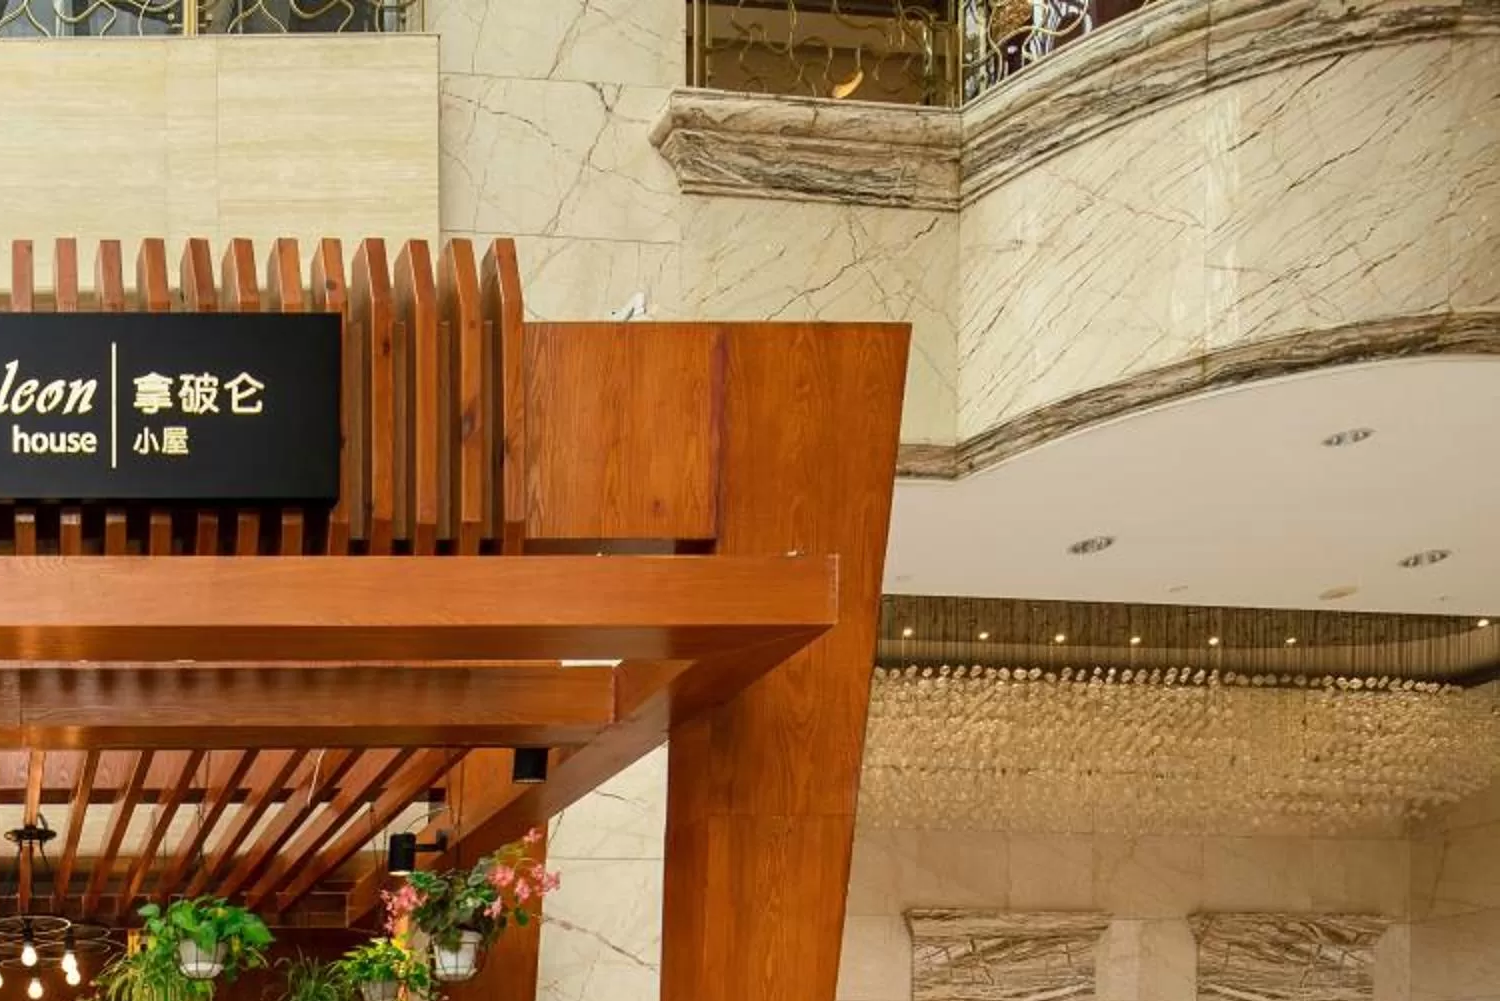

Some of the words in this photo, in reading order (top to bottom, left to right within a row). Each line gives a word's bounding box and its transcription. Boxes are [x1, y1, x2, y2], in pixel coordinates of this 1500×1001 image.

[132, 371, 266, 415] 拿破仑
[11, 423, 98, 454] house
[132, 426, 190, 456] 小屋
